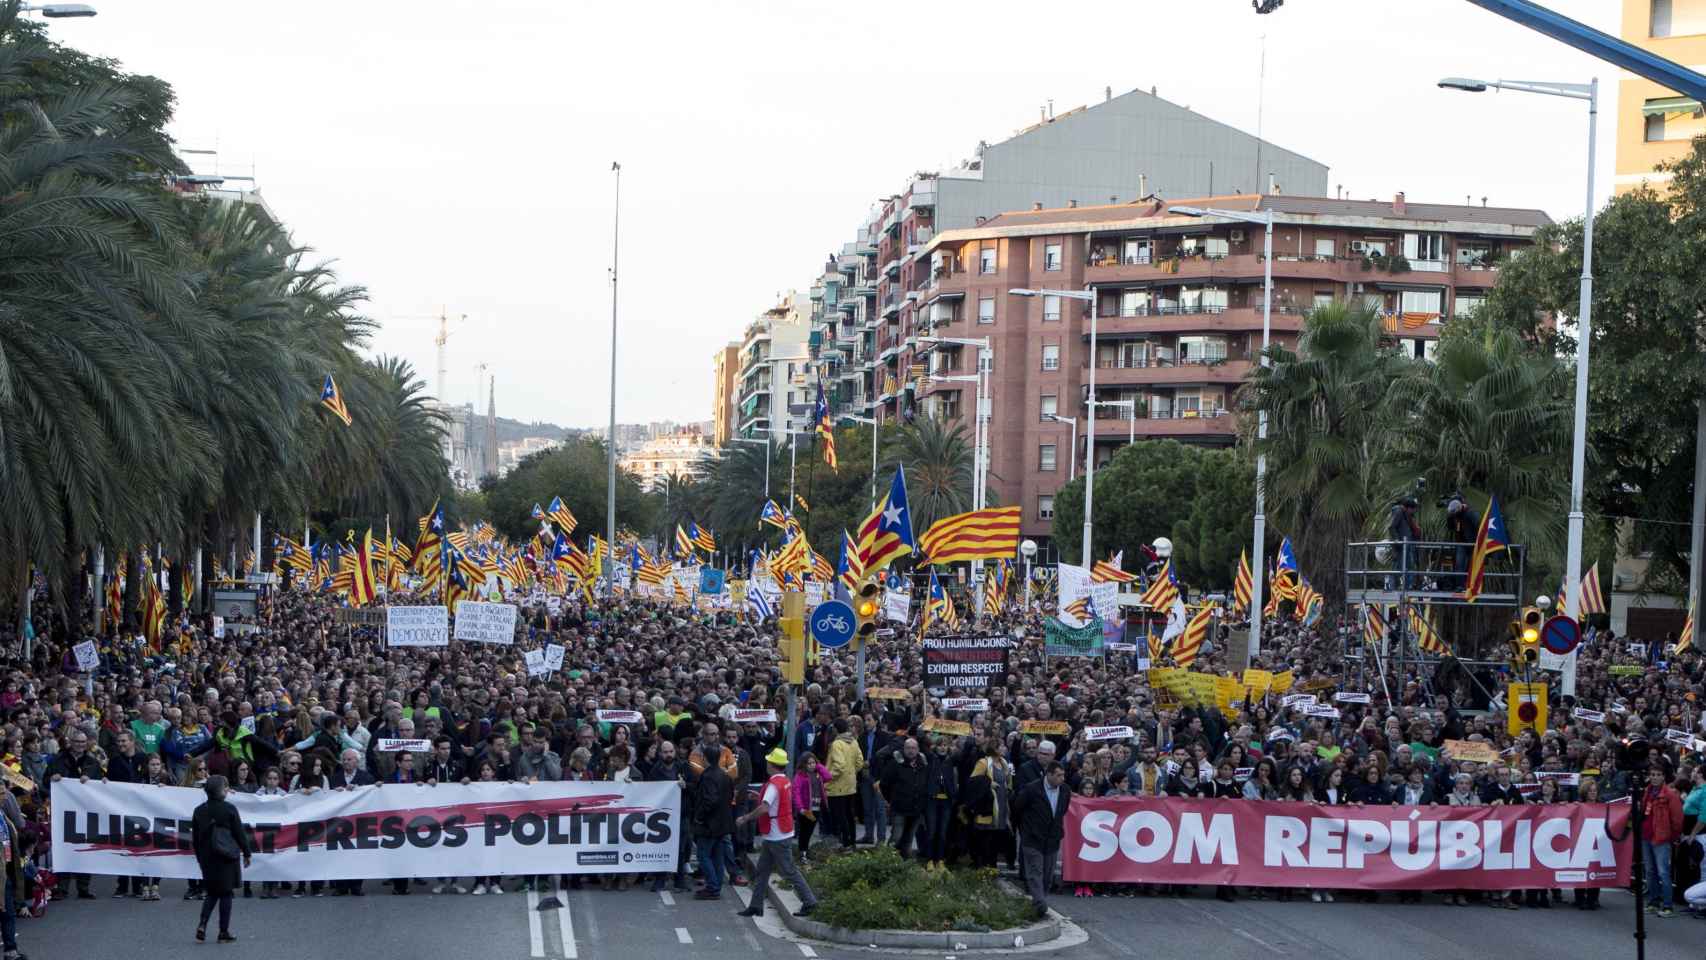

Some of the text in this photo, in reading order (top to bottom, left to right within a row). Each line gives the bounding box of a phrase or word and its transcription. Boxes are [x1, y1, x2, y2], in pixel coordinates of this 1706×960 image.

[923, 638, 945, 648] PROU
[928, 663, 1004, 674] EXIGIM RESPECTE
[949, 676, 989, 687] DIGNITAT
[64, 803, 672, 854] LLIBERAT PRESOS POLÍTICS
[1078, 808, 1616, 870] SOM REPÚBLICA
